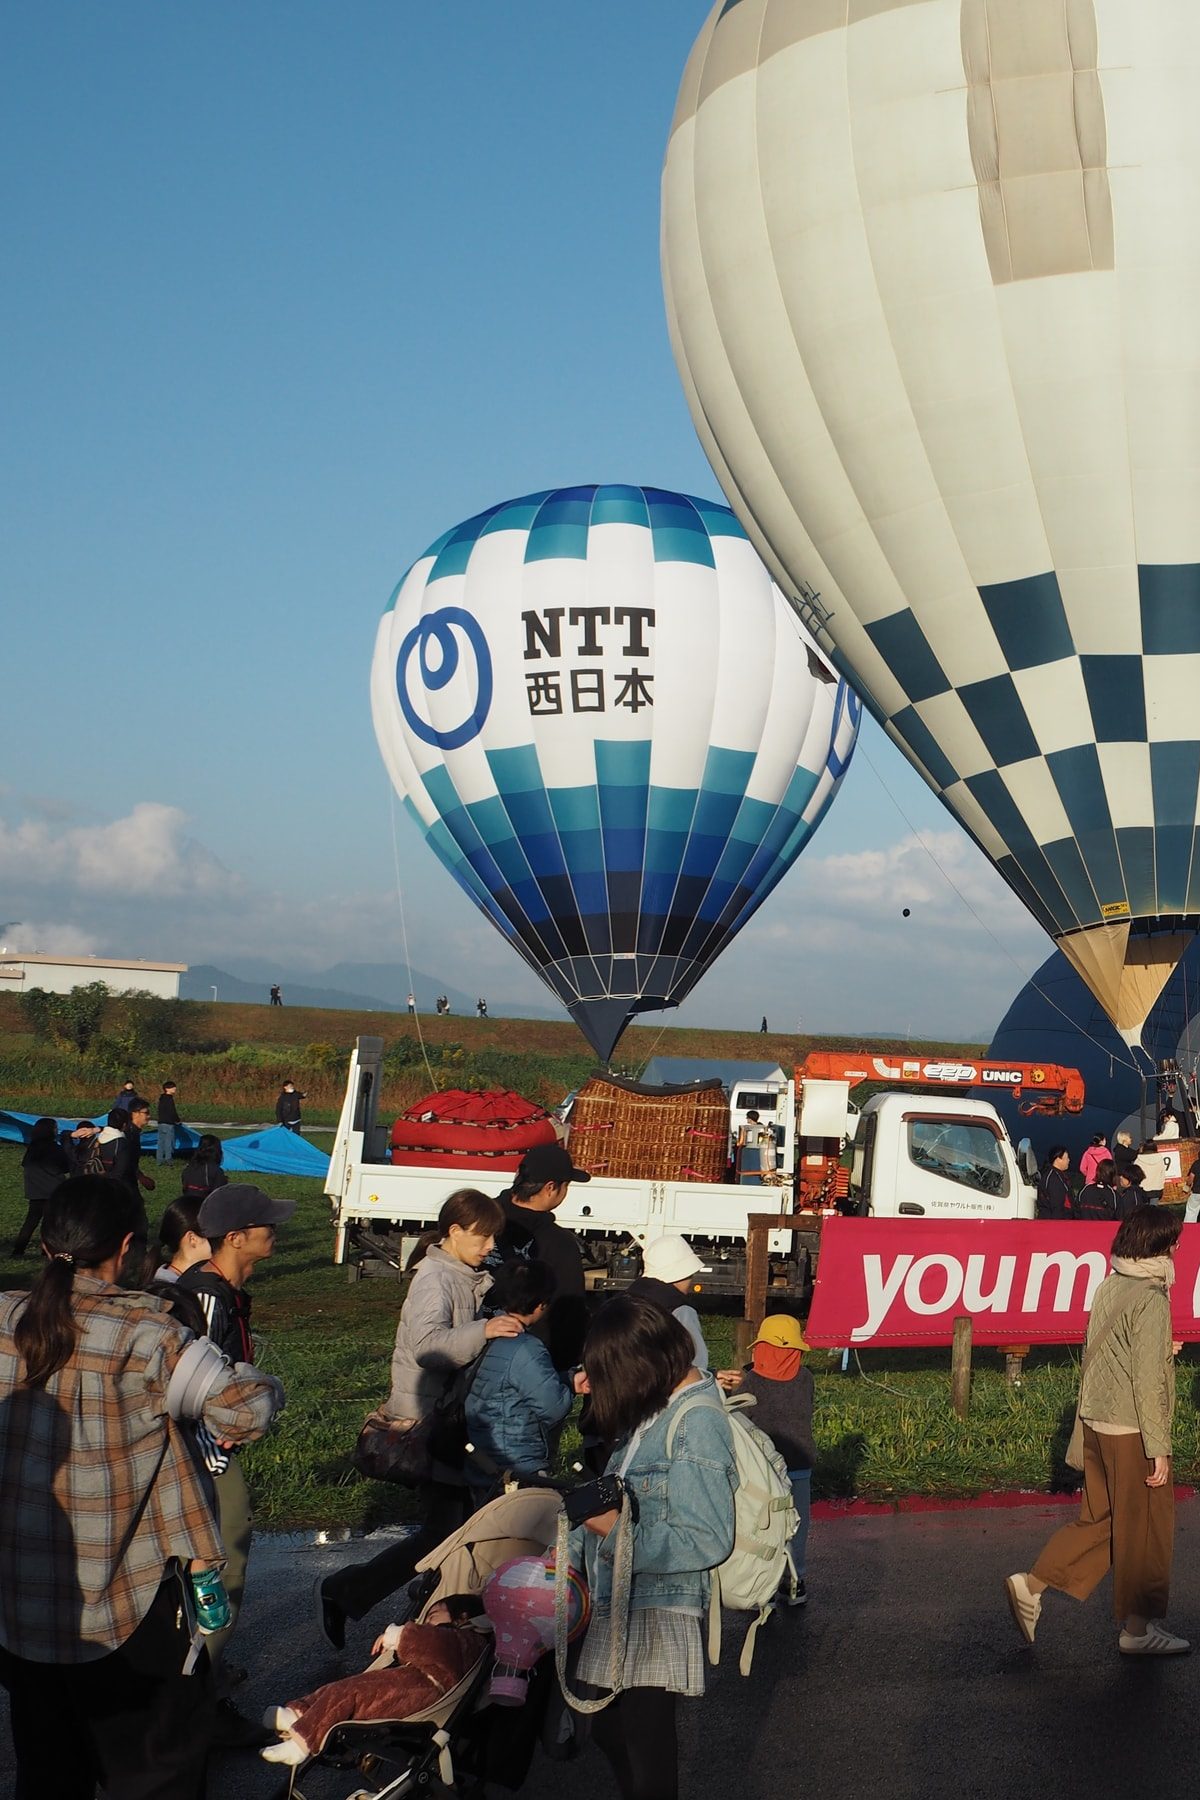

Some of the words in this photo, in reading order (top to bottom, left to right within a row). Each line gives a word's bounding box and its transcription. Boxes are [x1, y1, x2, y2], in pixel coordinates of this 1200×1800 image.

[521, 606, 656, 660] NTT
[525, 667, 655, 716] 西日本
[983, 1070, 1022, 1082] UNIC
[850, 1250, 1112, 1342] youm
